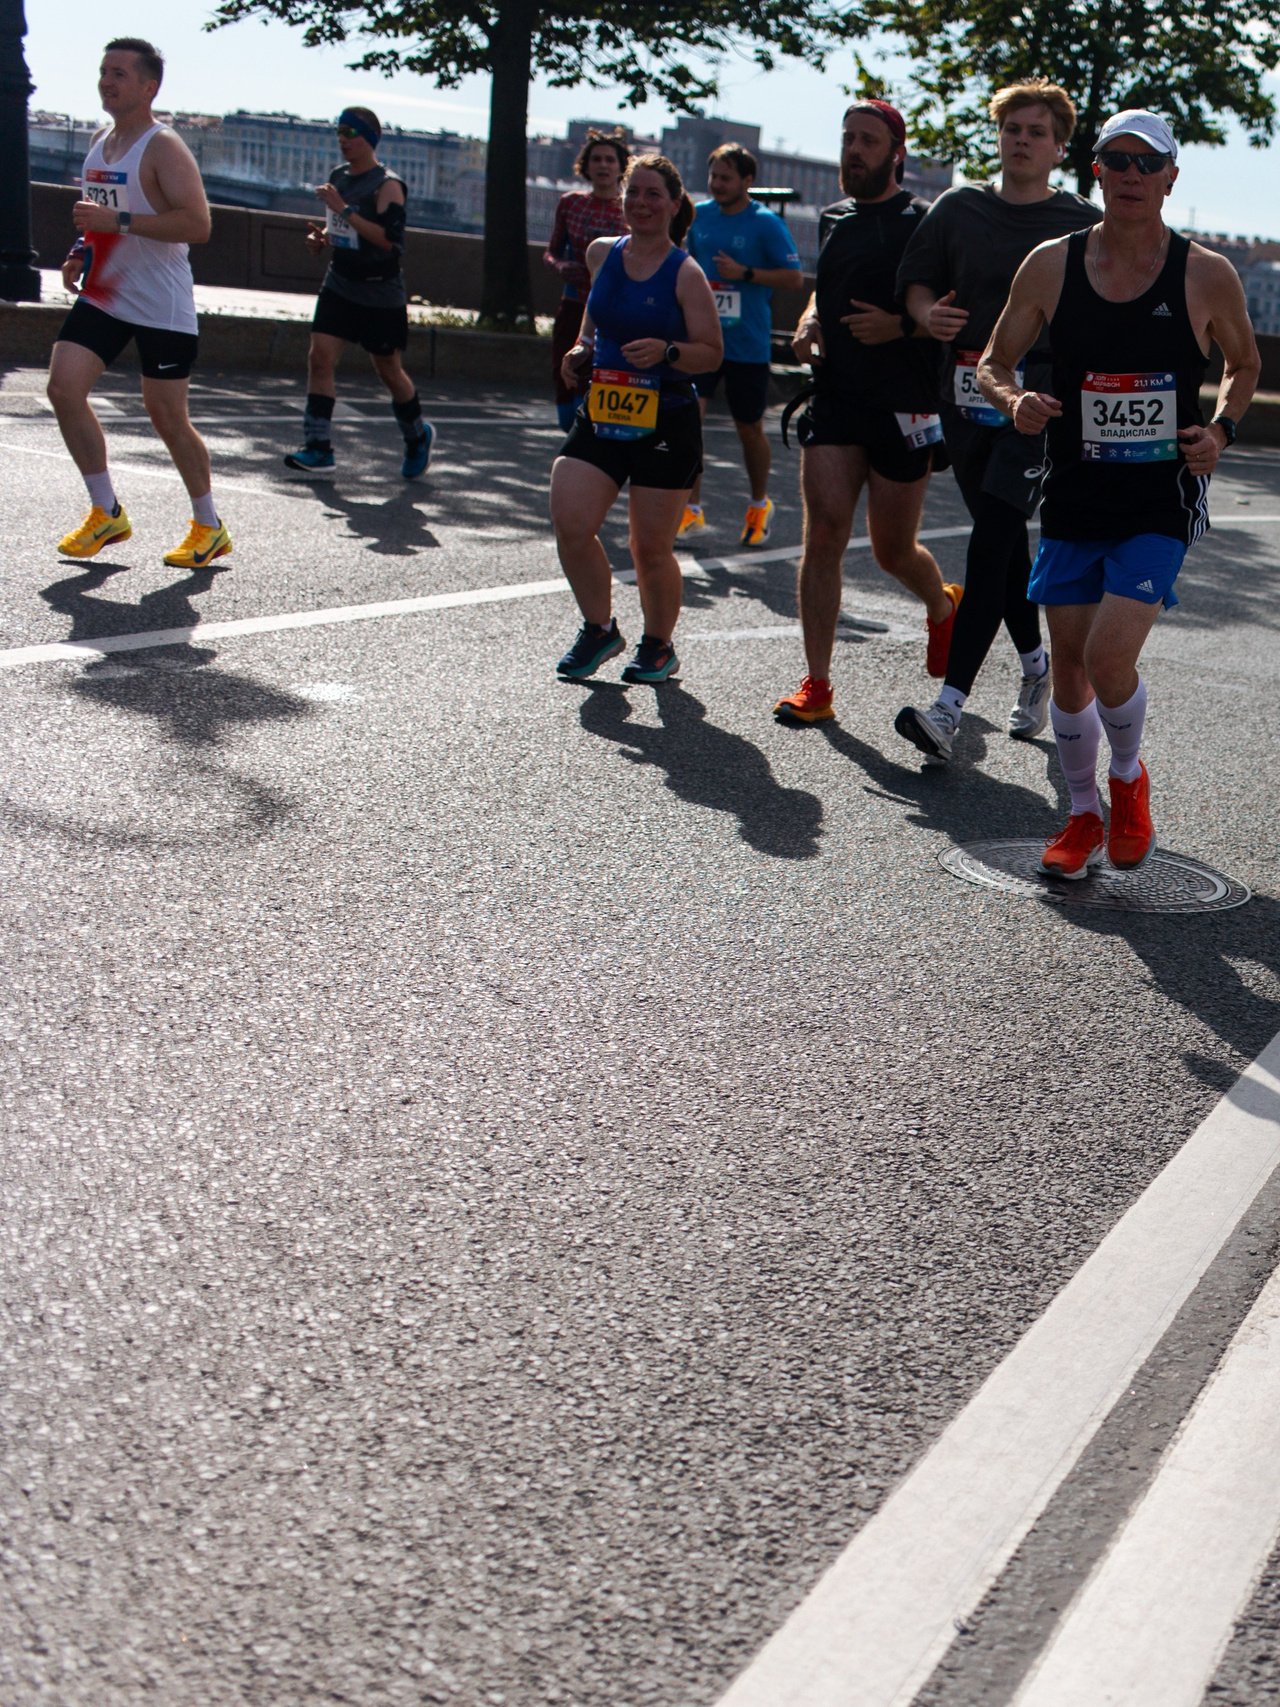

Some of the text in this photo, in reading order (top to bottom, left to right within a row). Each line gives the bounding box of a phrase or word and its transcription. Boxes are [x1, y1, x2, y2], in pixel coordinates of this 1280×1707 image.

[88, 187, 118, 207] 5731
[715, 294, 733, 310] 71
[1092, 380, 1121, 388] МАРАФОН
[597, 389, 649, 414] 1047
[608, 412, 631, 421] ЕЛЕНА
[1093, 399, 1164, 426] 3452
[1100, 428, 1157, 438] ВЛАДИСЛАВ
[1091, 444, 1101, 458] E
